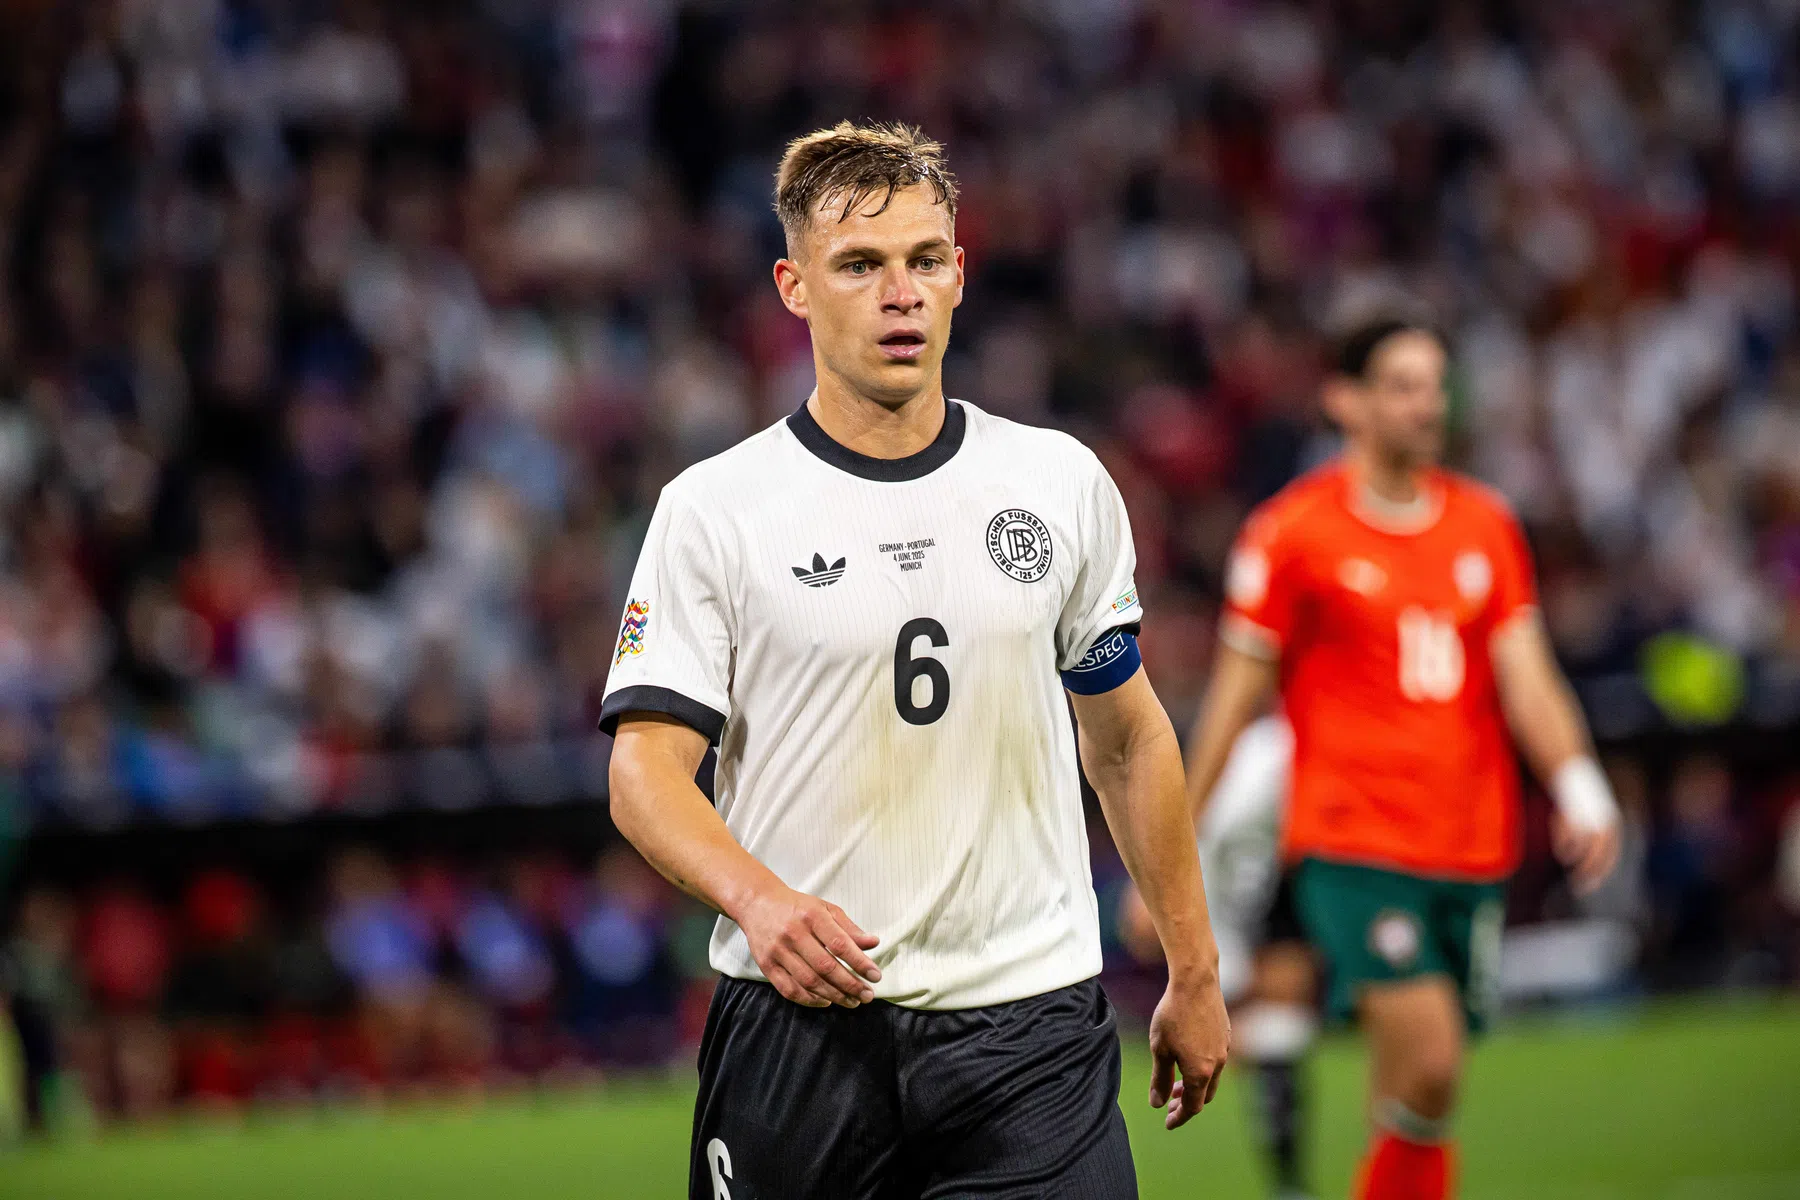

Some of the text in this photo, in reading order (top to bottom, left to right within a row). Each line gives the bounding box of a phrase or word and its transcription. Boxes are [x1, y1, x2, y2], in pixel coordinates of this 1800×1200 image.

[898, 552, 911, 562] JUNE
[911, 550, 925, 560] 2025
[990, 516, 1013, 572] DEUTSCHER
[899, 560, 922, 572] MUNICH
[1019, 571, 1032, 580] 125
[1075, 631, 1125, 667] SPECT
[894, 617, 950, 726] 6
